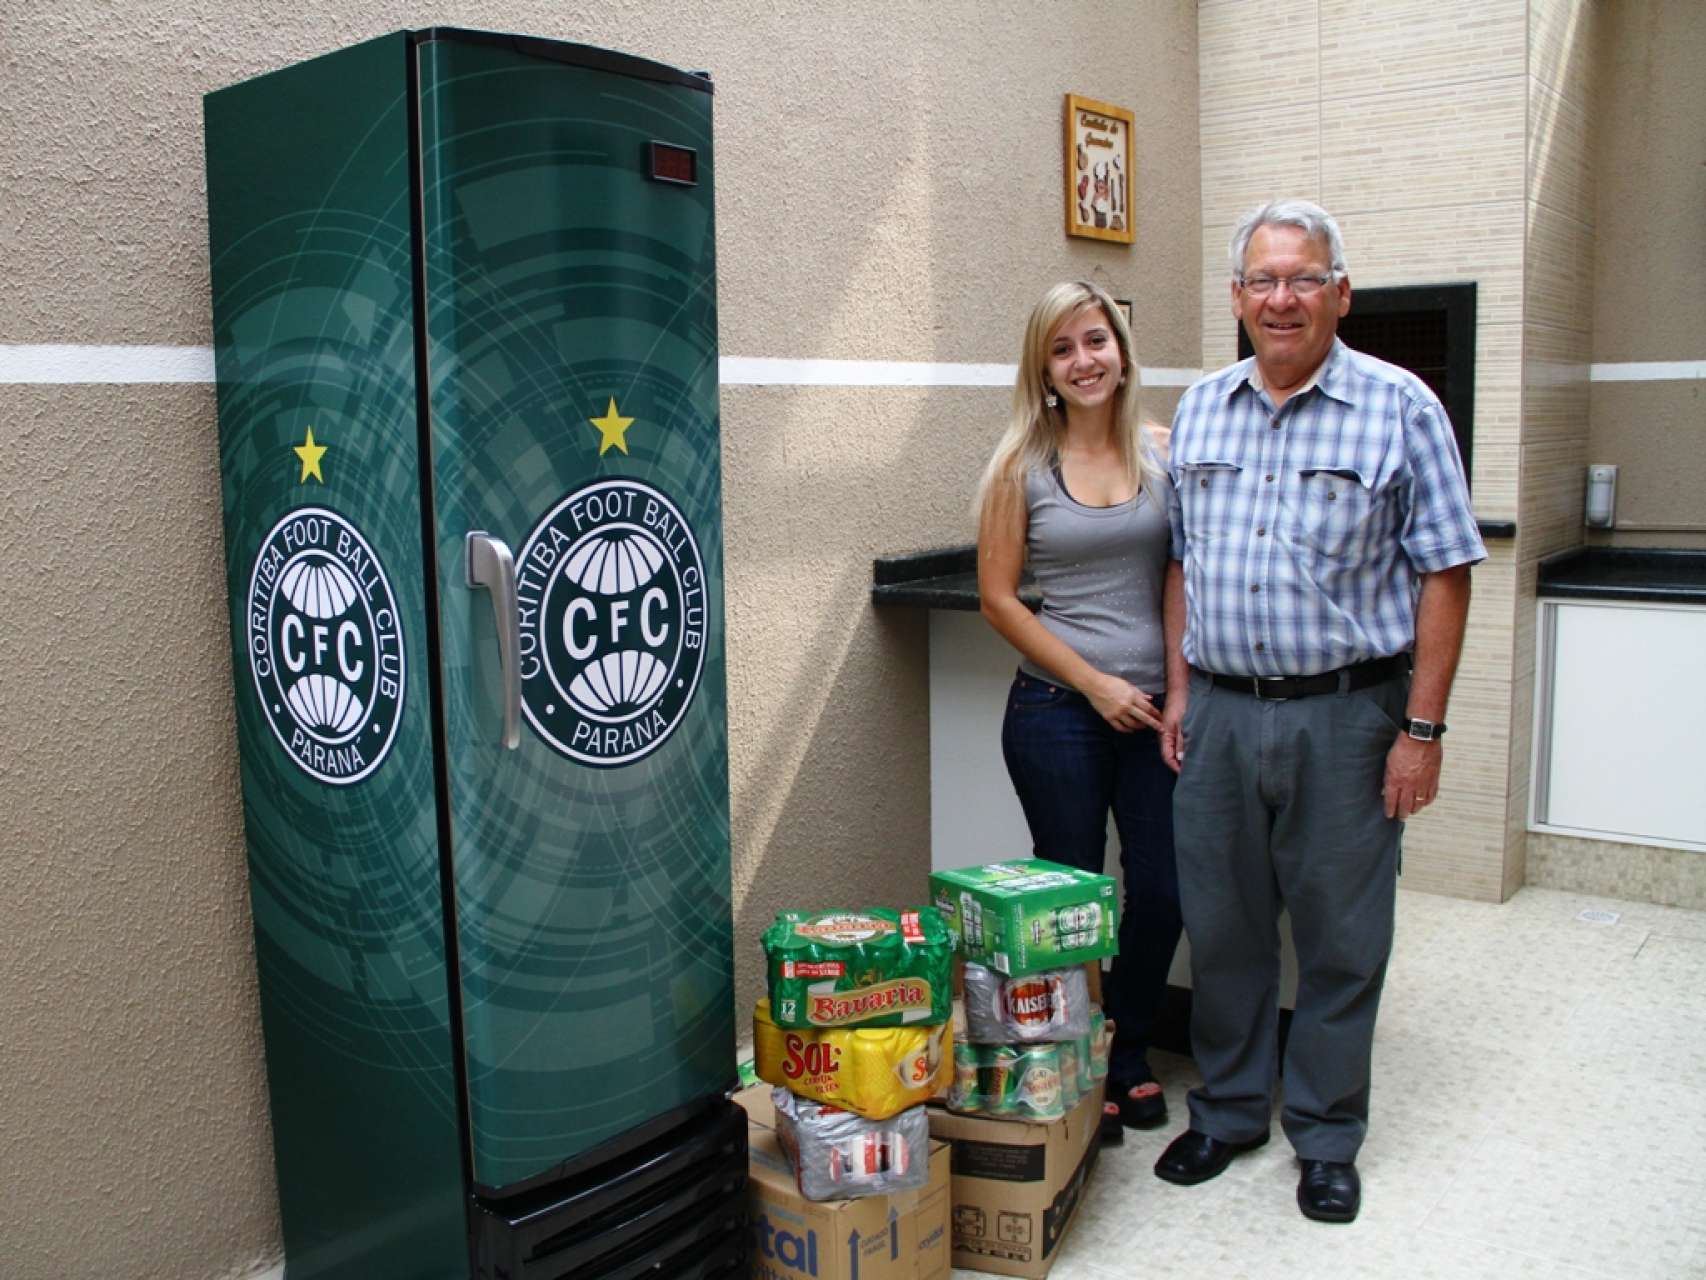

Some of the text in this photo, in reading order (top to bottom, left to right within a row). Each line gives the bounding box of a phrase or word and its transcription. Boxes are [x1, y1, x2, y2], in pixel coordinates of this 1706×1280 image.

[251, 517, 399, 701] CORITIBA FOOT BALL CLUB
[518, 490, 702, 680] CORITIBA FOOT BALL CLUB
[570, 698, 668, 755] PARANÁ
[290, 727, 366, 776] PARANÁ
[780, 1000, 797, 1014] 12
[812, 981, 925, 1023] Bavaria
[782, 1032, 841, 1080] SOL
